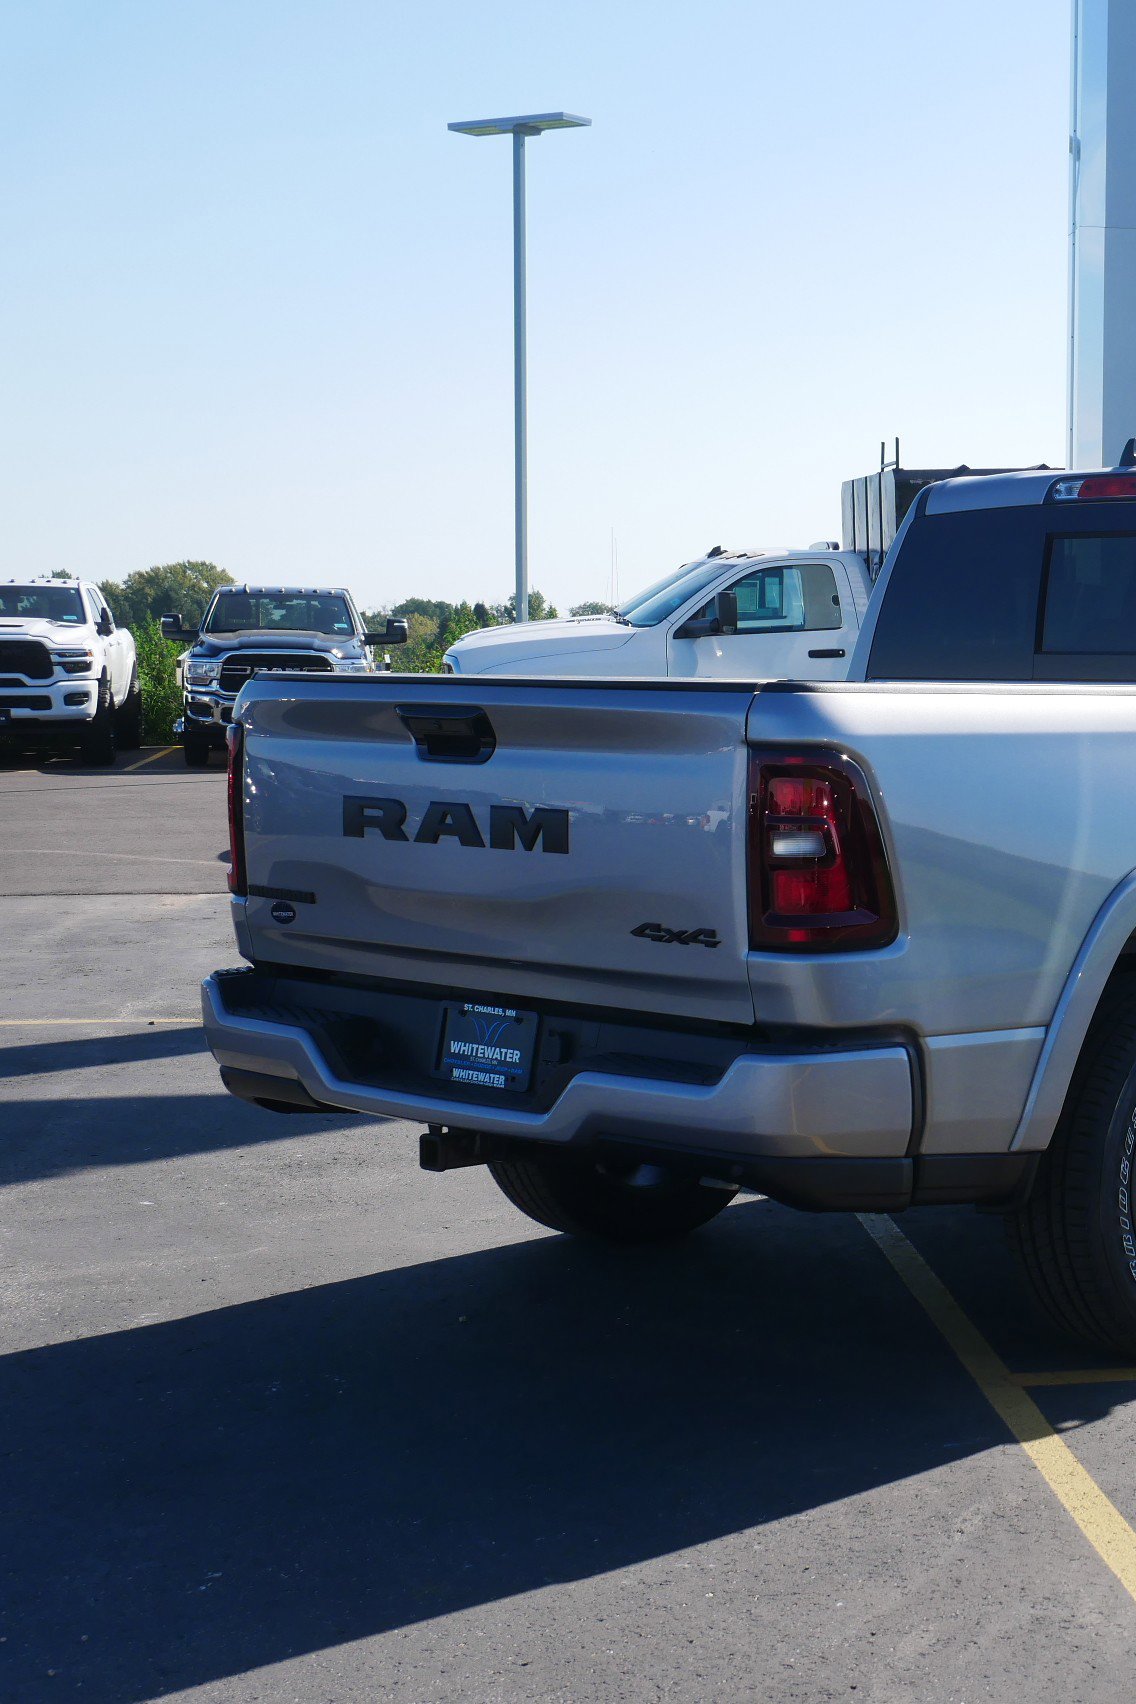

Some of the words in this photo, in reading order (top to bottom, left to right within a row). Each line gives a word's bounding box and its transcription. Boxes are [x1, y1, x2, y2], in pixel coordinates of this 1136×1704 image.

[343, 795, 569, 855] RAM
[464, 1003, 473, 1011] ST.
[474, 1005, 504, 1016] CHARLES,
[505, 1009, 516, 1017] MN
[450, 1040, 521, 1063] WHITEWATER
[452, 1067, 505, 1085] WHITEWATER
